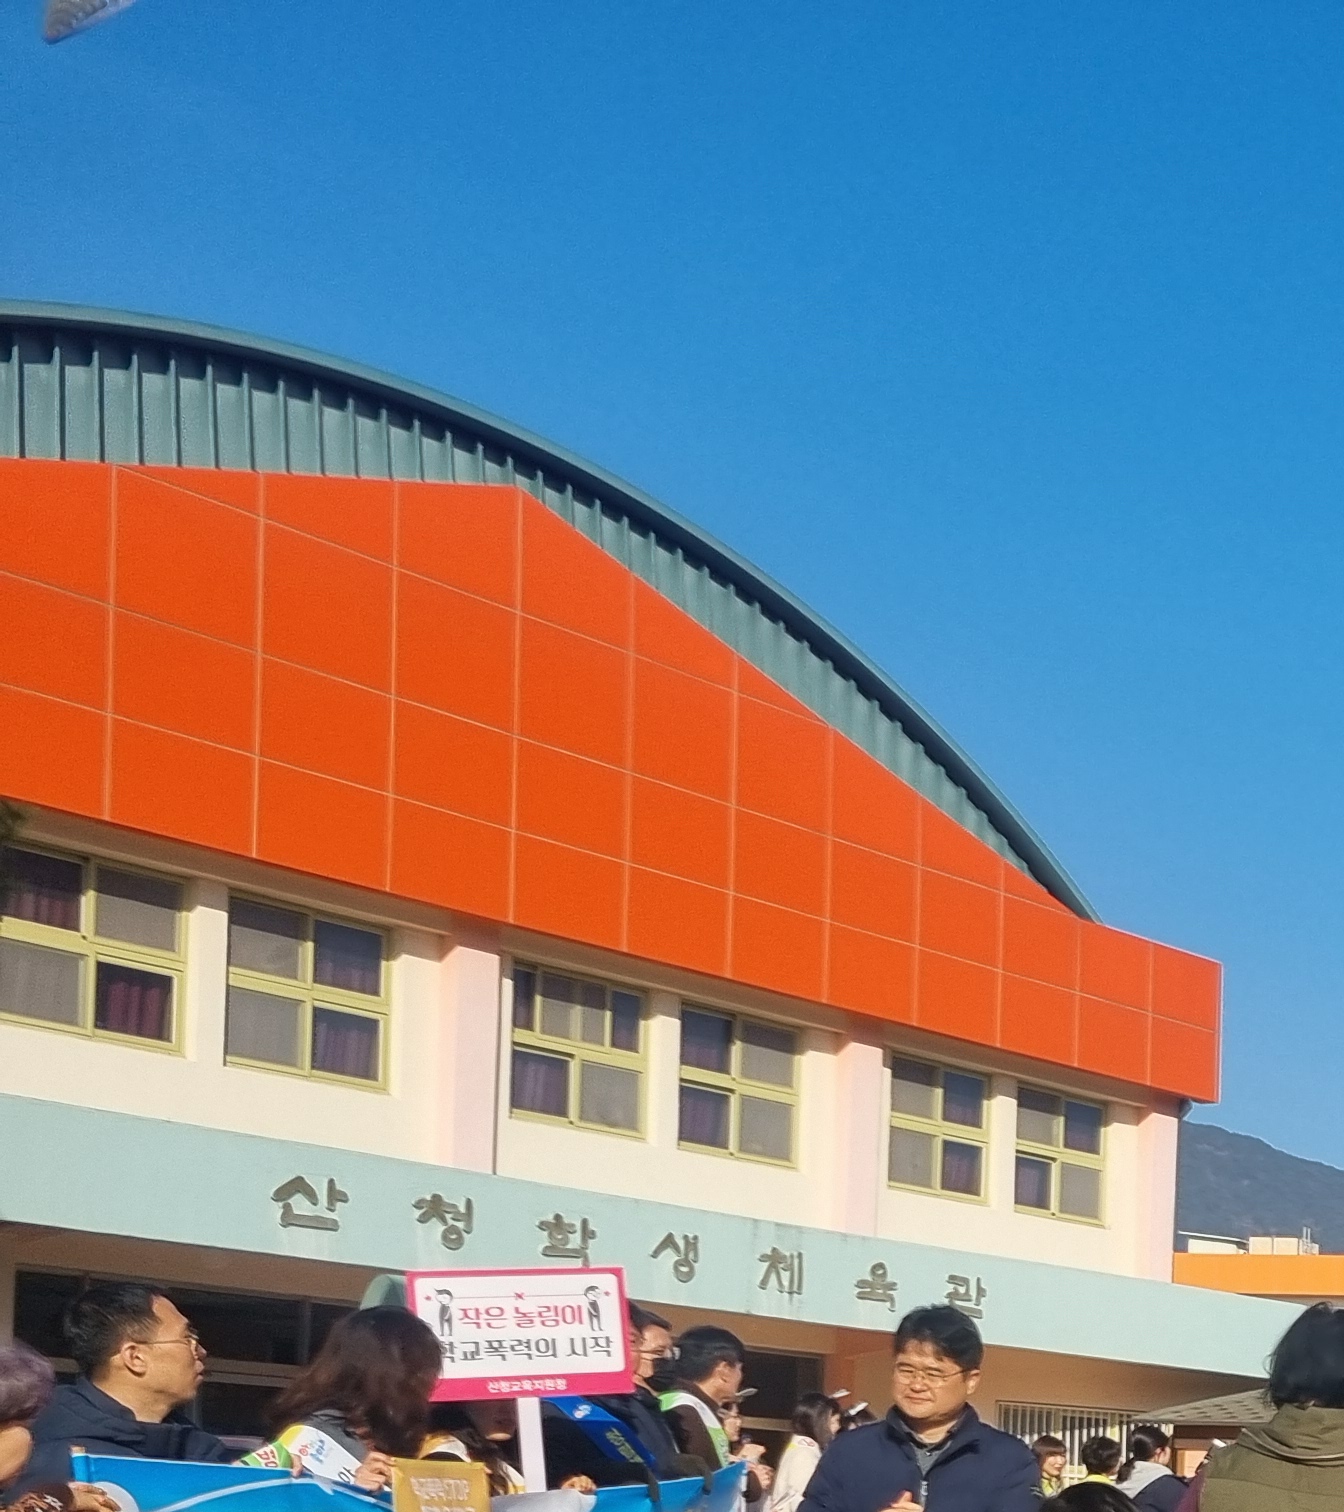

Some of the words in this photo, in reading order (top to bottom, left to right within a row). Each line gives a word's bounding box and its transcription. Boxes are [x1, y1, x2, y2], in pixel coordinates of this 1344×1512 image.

[271, 1174, 986, 1318] 산청학생체육관
[458, 1307, 507, 1330] 작은
[513, 1304, 584, 1328] 놀림이
[565, 1336, 614, 1358] 시작
